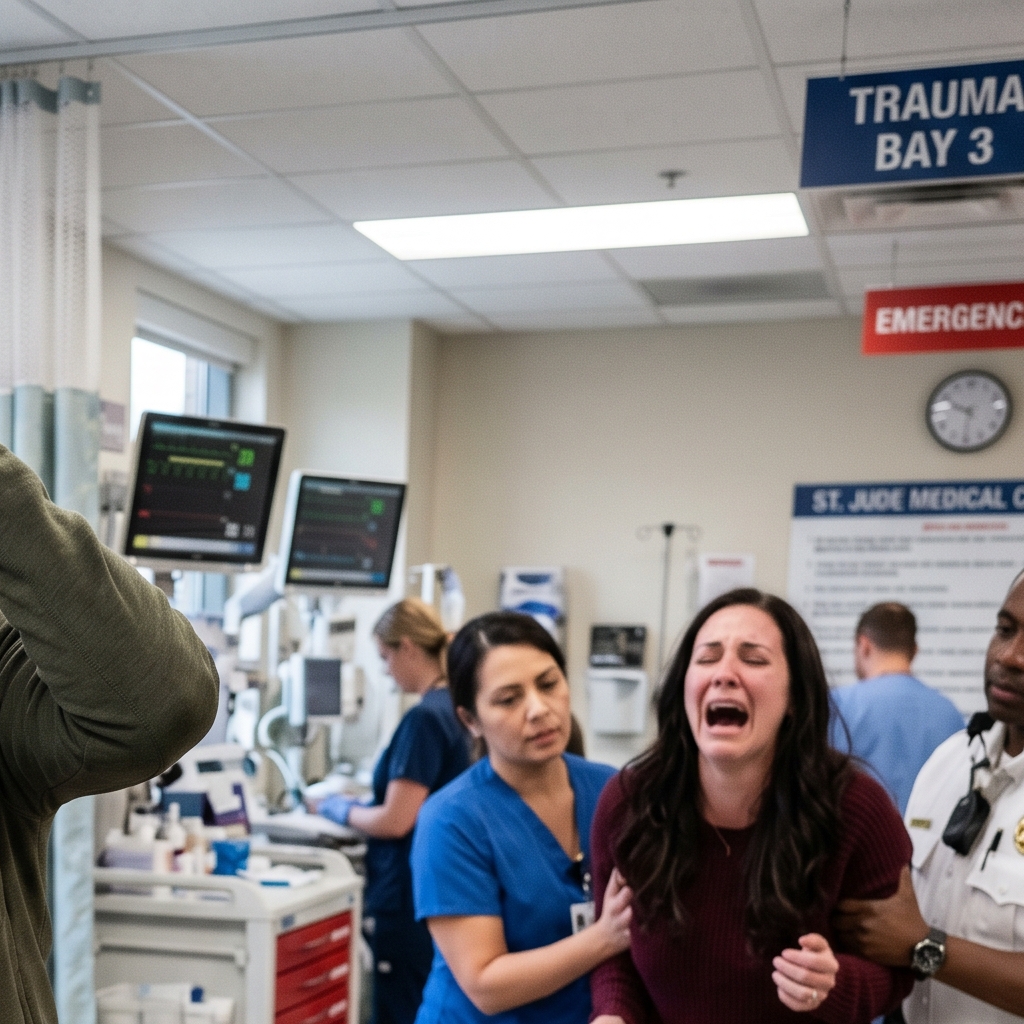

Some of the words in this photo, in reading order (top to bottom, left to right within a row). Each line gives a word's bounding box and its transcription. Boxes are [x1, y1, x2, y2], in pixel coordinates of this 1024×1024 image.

[849, 74, 1024, 125] TRAUMA
[875, 128, 958, 171] BAY
[967, 127, 994, 165] 3
[908, 485, 1008, 511] MEDICAL
